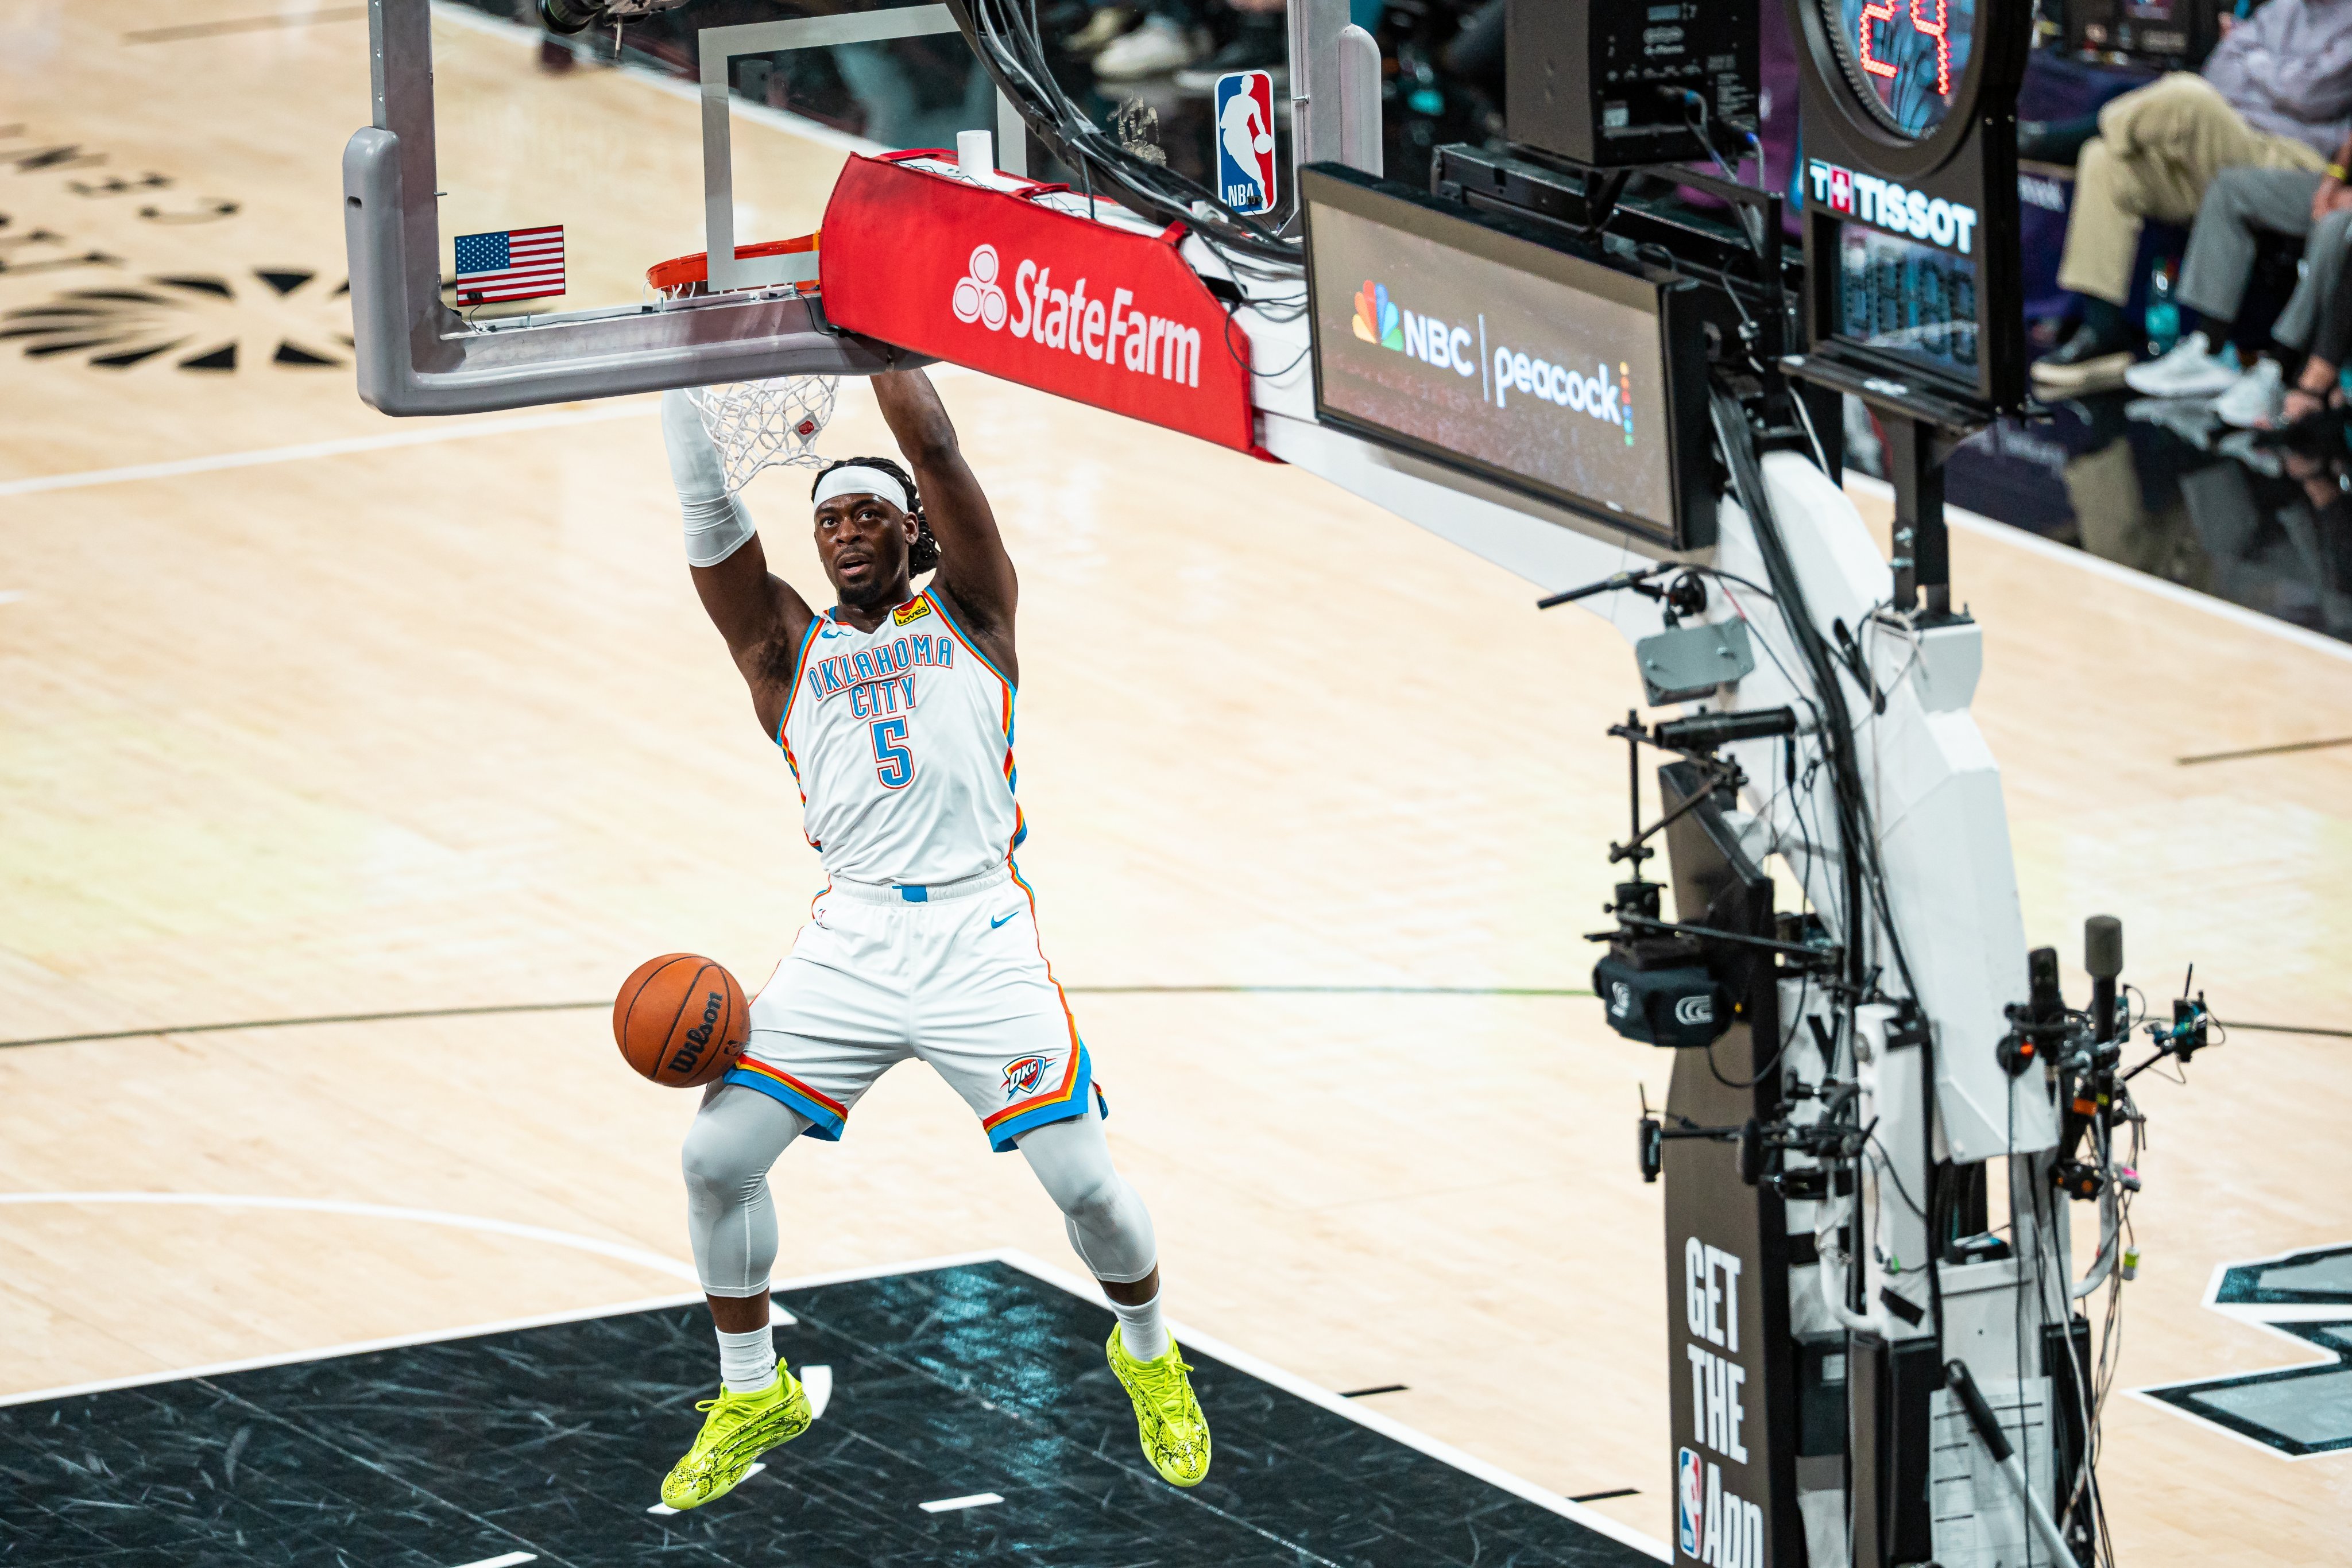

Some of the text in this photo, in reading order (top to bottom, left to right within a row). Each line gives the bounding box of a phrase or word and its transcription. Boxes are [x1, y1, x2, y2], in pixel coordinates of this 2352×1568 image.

[1228, 183, 1254, 207] NBA
[1854, 172, 1977, 254] TISSOT
[1403, 309, 1623, 426] NBC peacock
[807, 634, 954, 702] OKLAHOMA
[849, 673, 916, 719] CITY
[869, 715, 915, 789] 5
[667, 992, 723, 1073] Wilson
[1009, 1060, 1037, 1091] OKC
[1685, 1236, 1741, 1354] GET
[1687, 1342, 1748, 1465] THE
